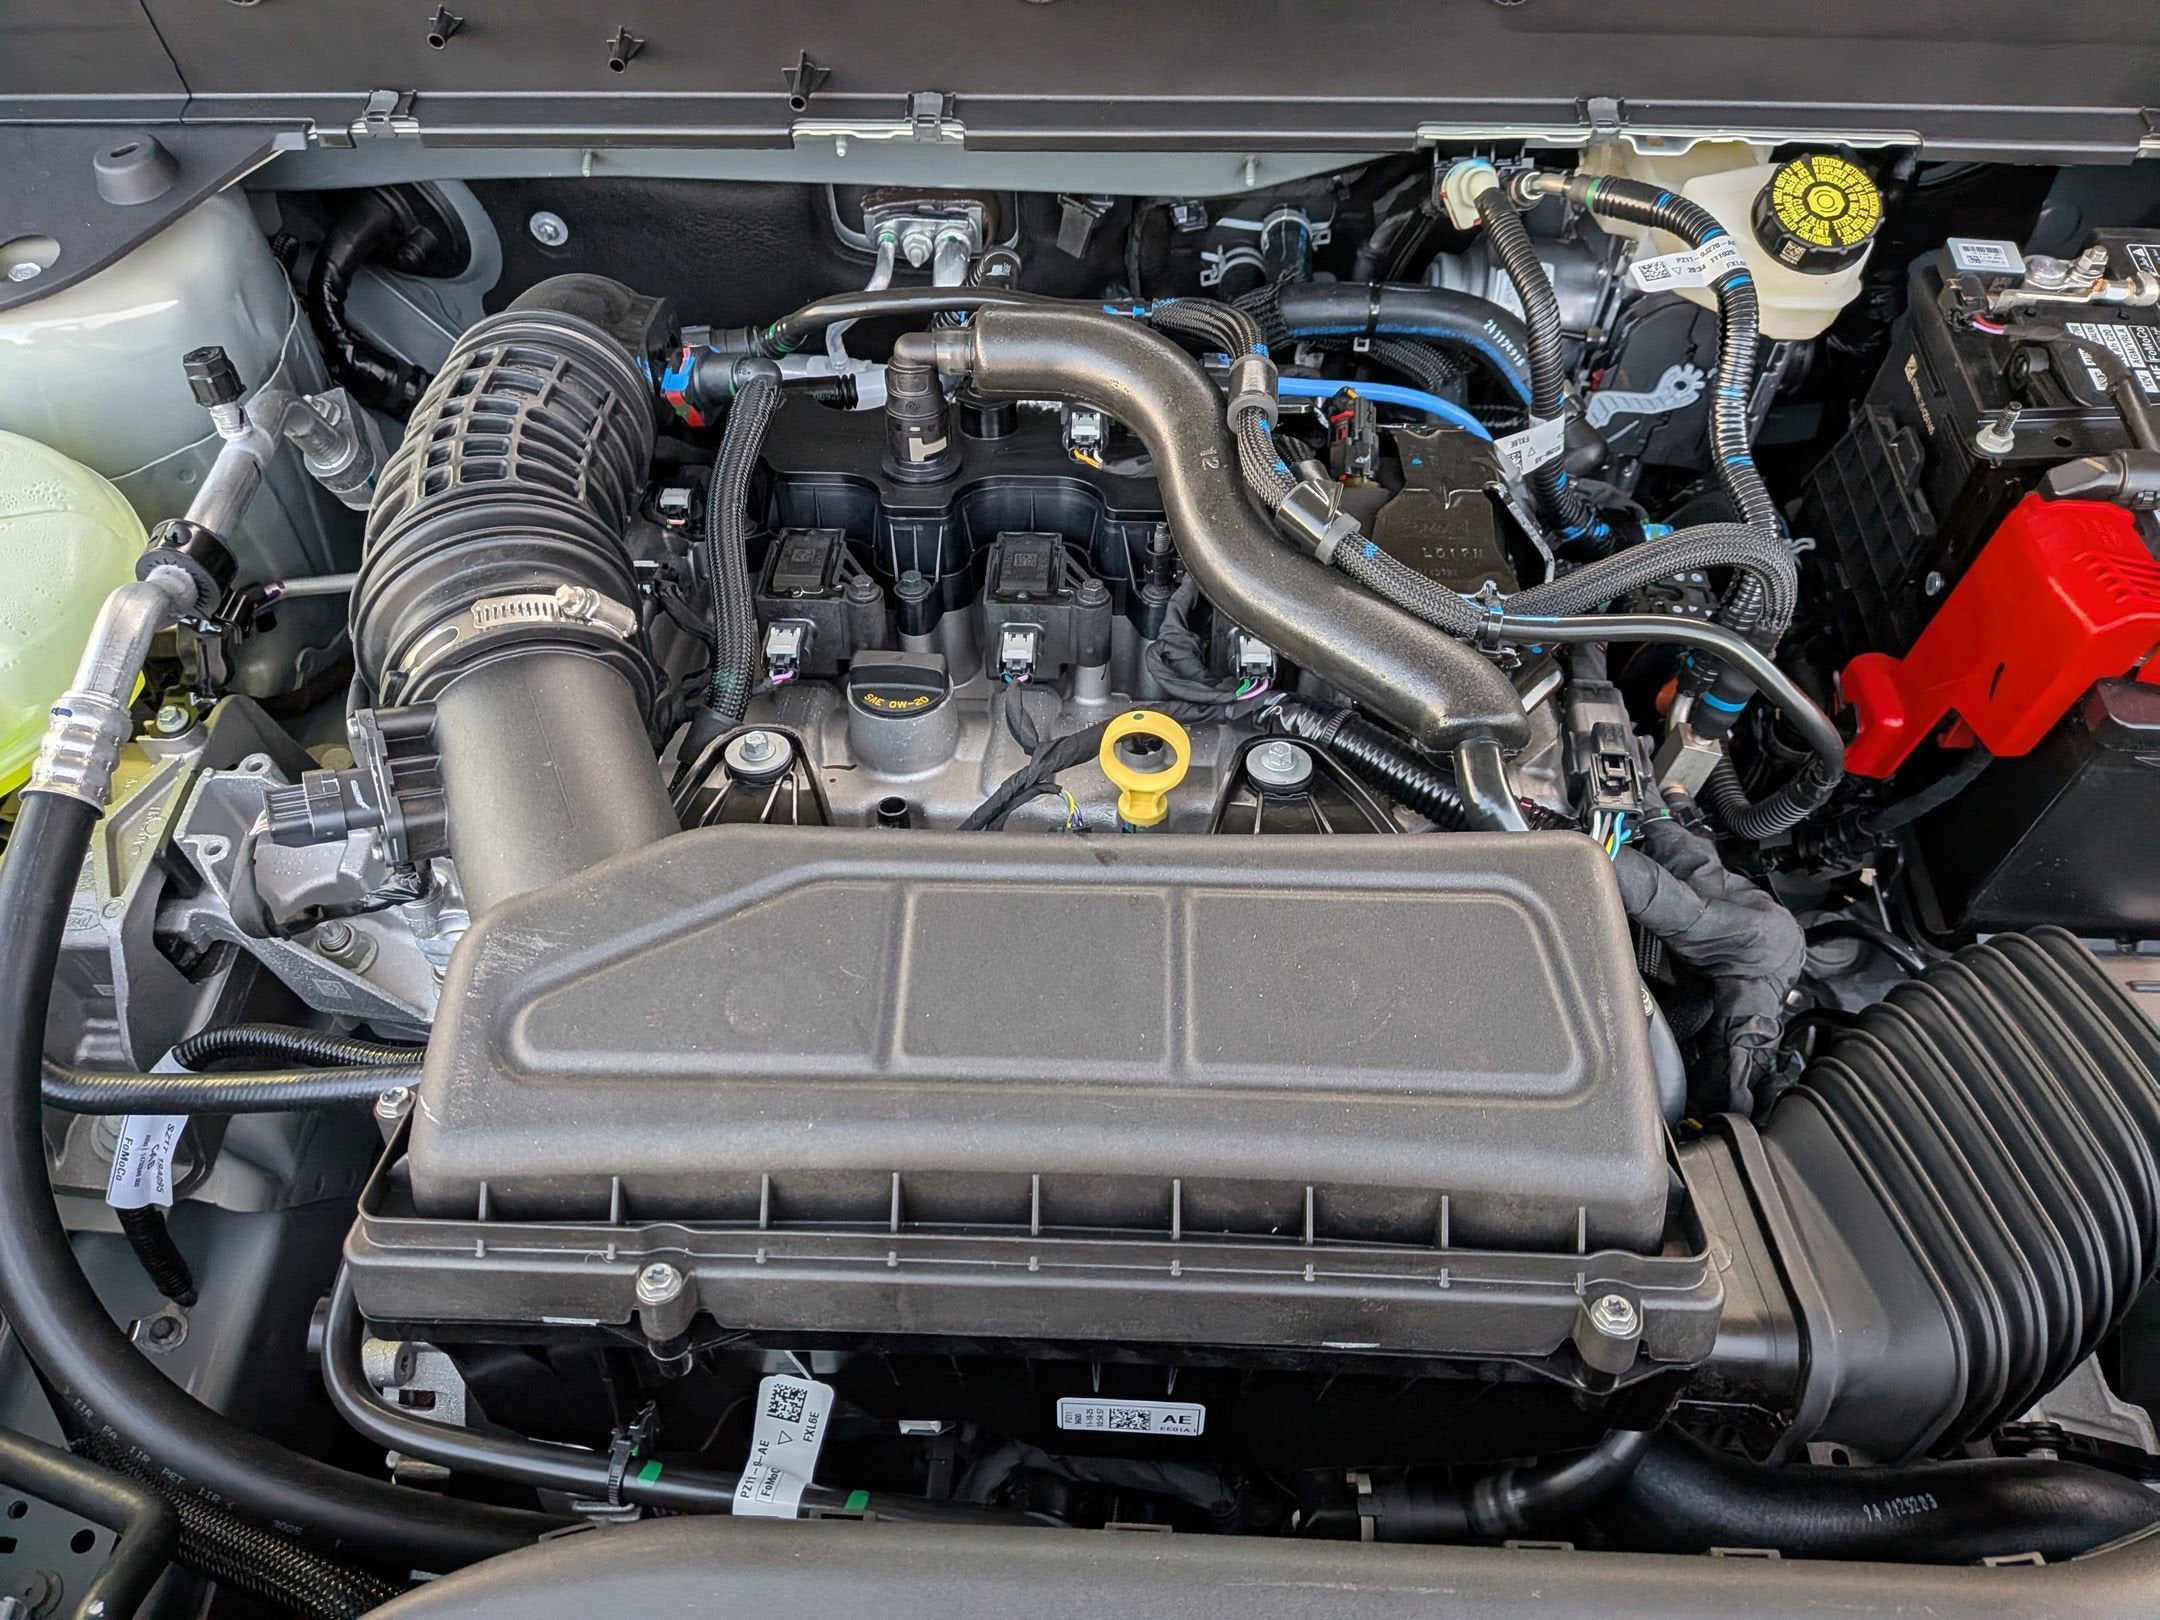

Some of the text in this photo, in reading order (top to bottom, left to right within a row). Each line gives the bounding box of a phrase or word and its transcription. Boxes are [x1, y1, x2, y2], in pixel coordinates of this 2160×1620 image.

[1863, 183, 1875, 192] LE
[1793, 198, 1808, 216] CLEAN
[1806, 215, 1829, 227] FILLER
[1777, 210, 1798, 231] SEALED
[1796, 228, 1832, 246] CONTAINER
[1797, 219, 1812, 231] USE
[1811, 226, 1829, 237] ONLY
[2136, 326, 2158, 361] FoMoCo
[864, 693, 929, 709] SAE 0W-20
[115, 1136, 134, 1181] FoMoCo
[803, 1411, 820, 1443] FXL6E
[1162, 1414, 1192, 1425] AE
[161, 1467, 186, 1485] PET
[761, 1467, 781, 1497] FoMoC
